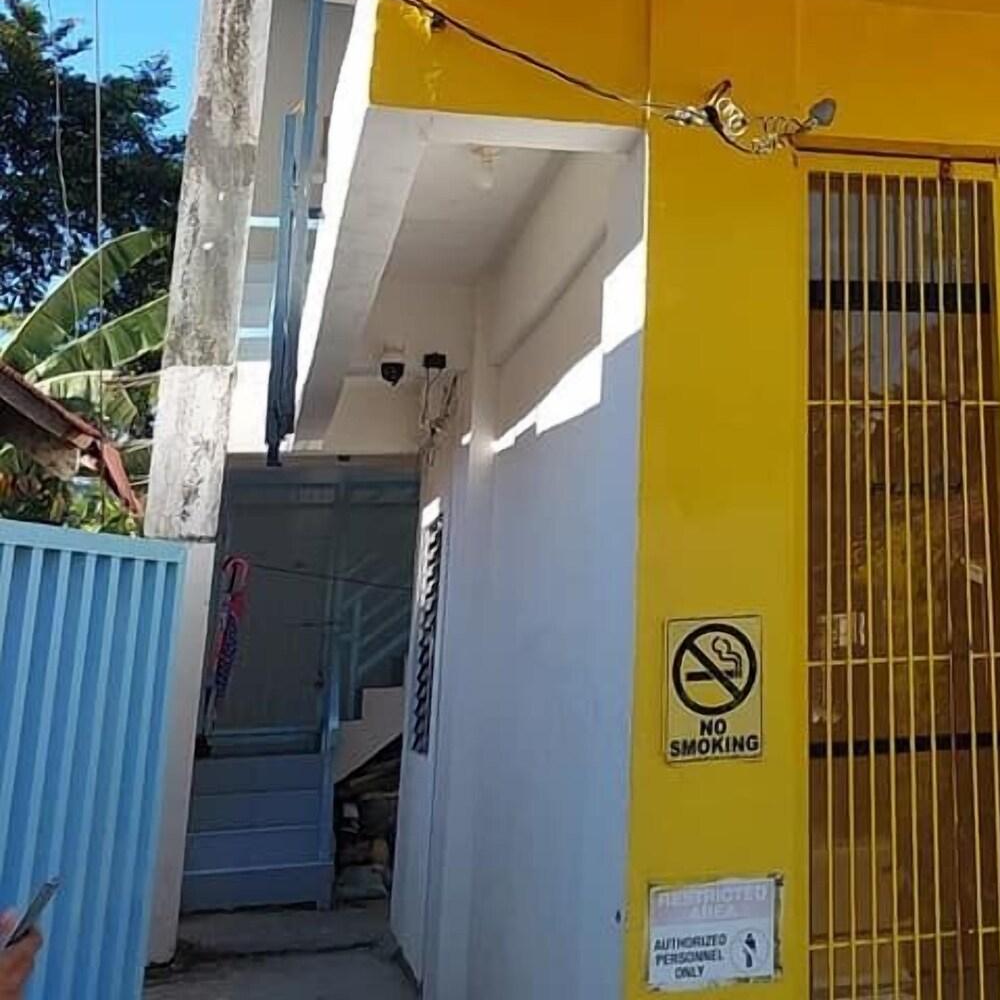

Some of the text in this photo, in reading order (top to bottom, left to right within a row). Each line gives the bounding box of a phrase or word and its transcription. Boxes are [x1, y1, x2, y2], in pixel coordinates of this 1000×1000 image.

[700, 719, 726, 737] NO
[670, 735, 759, 757] SMOKING
[654, 933, 727, 950] AUTHORIZED
[656, 949, 724, 966] PERSONNEL
[674, 965, 705, 979] ONLY
